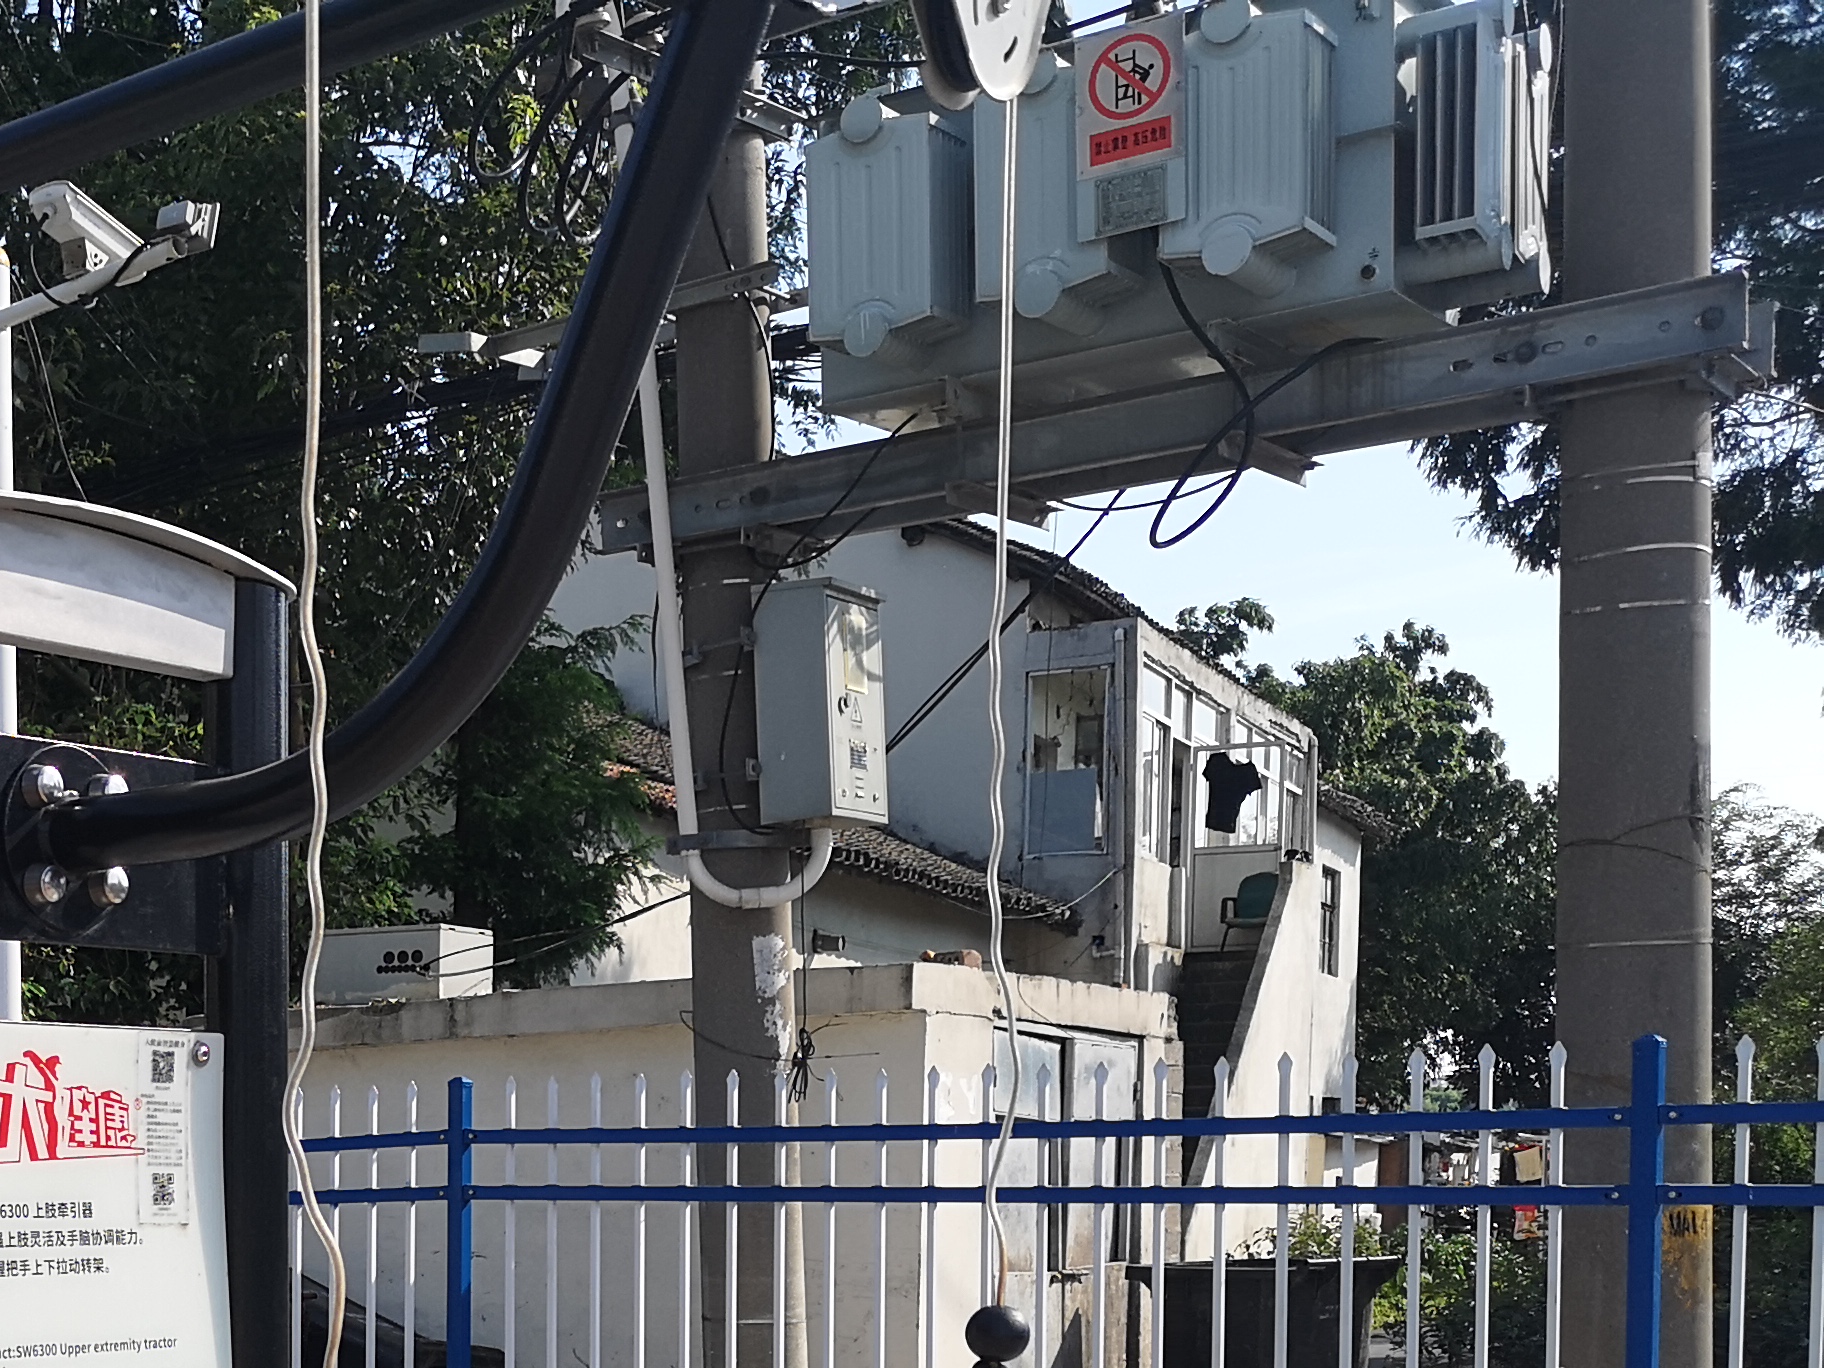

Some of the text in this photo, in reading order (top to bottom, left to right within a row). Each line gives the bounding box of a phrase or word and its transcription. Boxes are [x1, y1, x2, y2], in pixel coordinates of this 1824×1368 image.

[33, 1202, 93, 1218] 上肢牵引器
[60, 1342, 92, 1357] Upper
[94, 1338, 142, 1353] extremity
[144, 1337, 177, 1350] tractor
